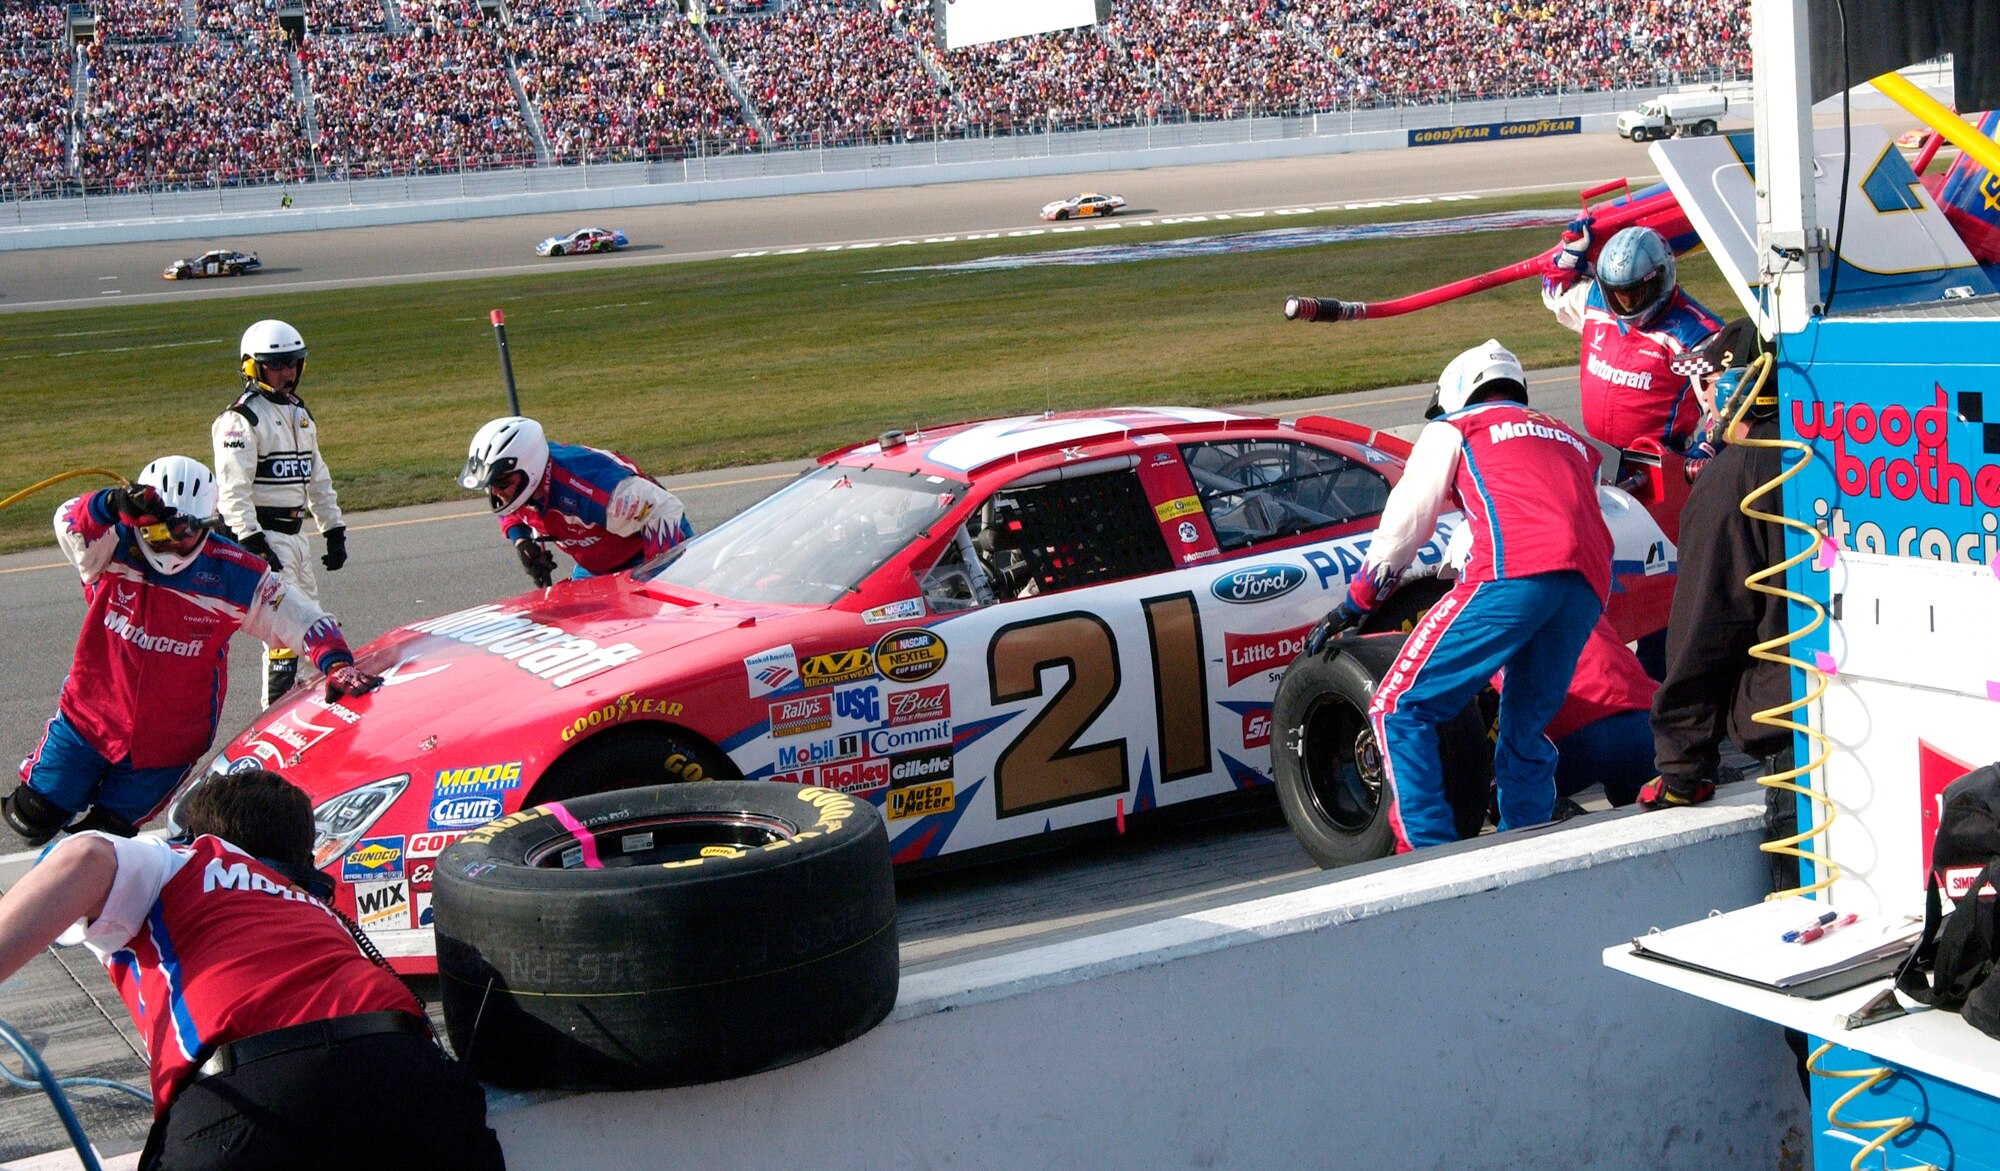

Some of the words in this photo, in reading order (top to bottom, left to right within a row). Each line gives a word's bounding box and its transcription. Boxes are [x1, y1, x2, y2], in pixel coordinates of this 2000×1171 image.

[1415, 126, 1490, 142] GOODYEAR
[1499, 119, 1575, 136] GOODYEAR
[577, 240, 591, 252] 25
[1586, 352, 1653, 391] Motorcraft
[1720, 350, 1734, 368] 2
[1791, 380, 1948, 448] wood
[1231, 566, 1289, 598] Ford
[103, 609, 204, 657] Motorcraft
[900, 634, 928, 650] NASCAR
[889, 649, 934, 666] NEXTEL
[1231, 642, 1276, 666] Little
[804, 675, 849, 688] MECHANIX
[849, 666, 874, 679] WEAR
[836, 685, 880, 722] USG
[889, 688, 947, 715] Bud
[987, 590, 1212, 820] 21
[561, 698, 684, 742] GOODYEAR
[870, 720, 950, 754] Commit
[778, 739, 834, 766] Mobil
[435, 761, 522, 789] MOOG
[823, 762, 889, 788] Holley
[892, 757, 951, 781] Gillette
[903, 796, 950, 815] Meter
[908, 786, 942, 801] Auto
[434, 799, 498, 821] CLEVITE
[348, 850, 400, 863] SUNOCO
[357, 883, 406, 915] WIX
